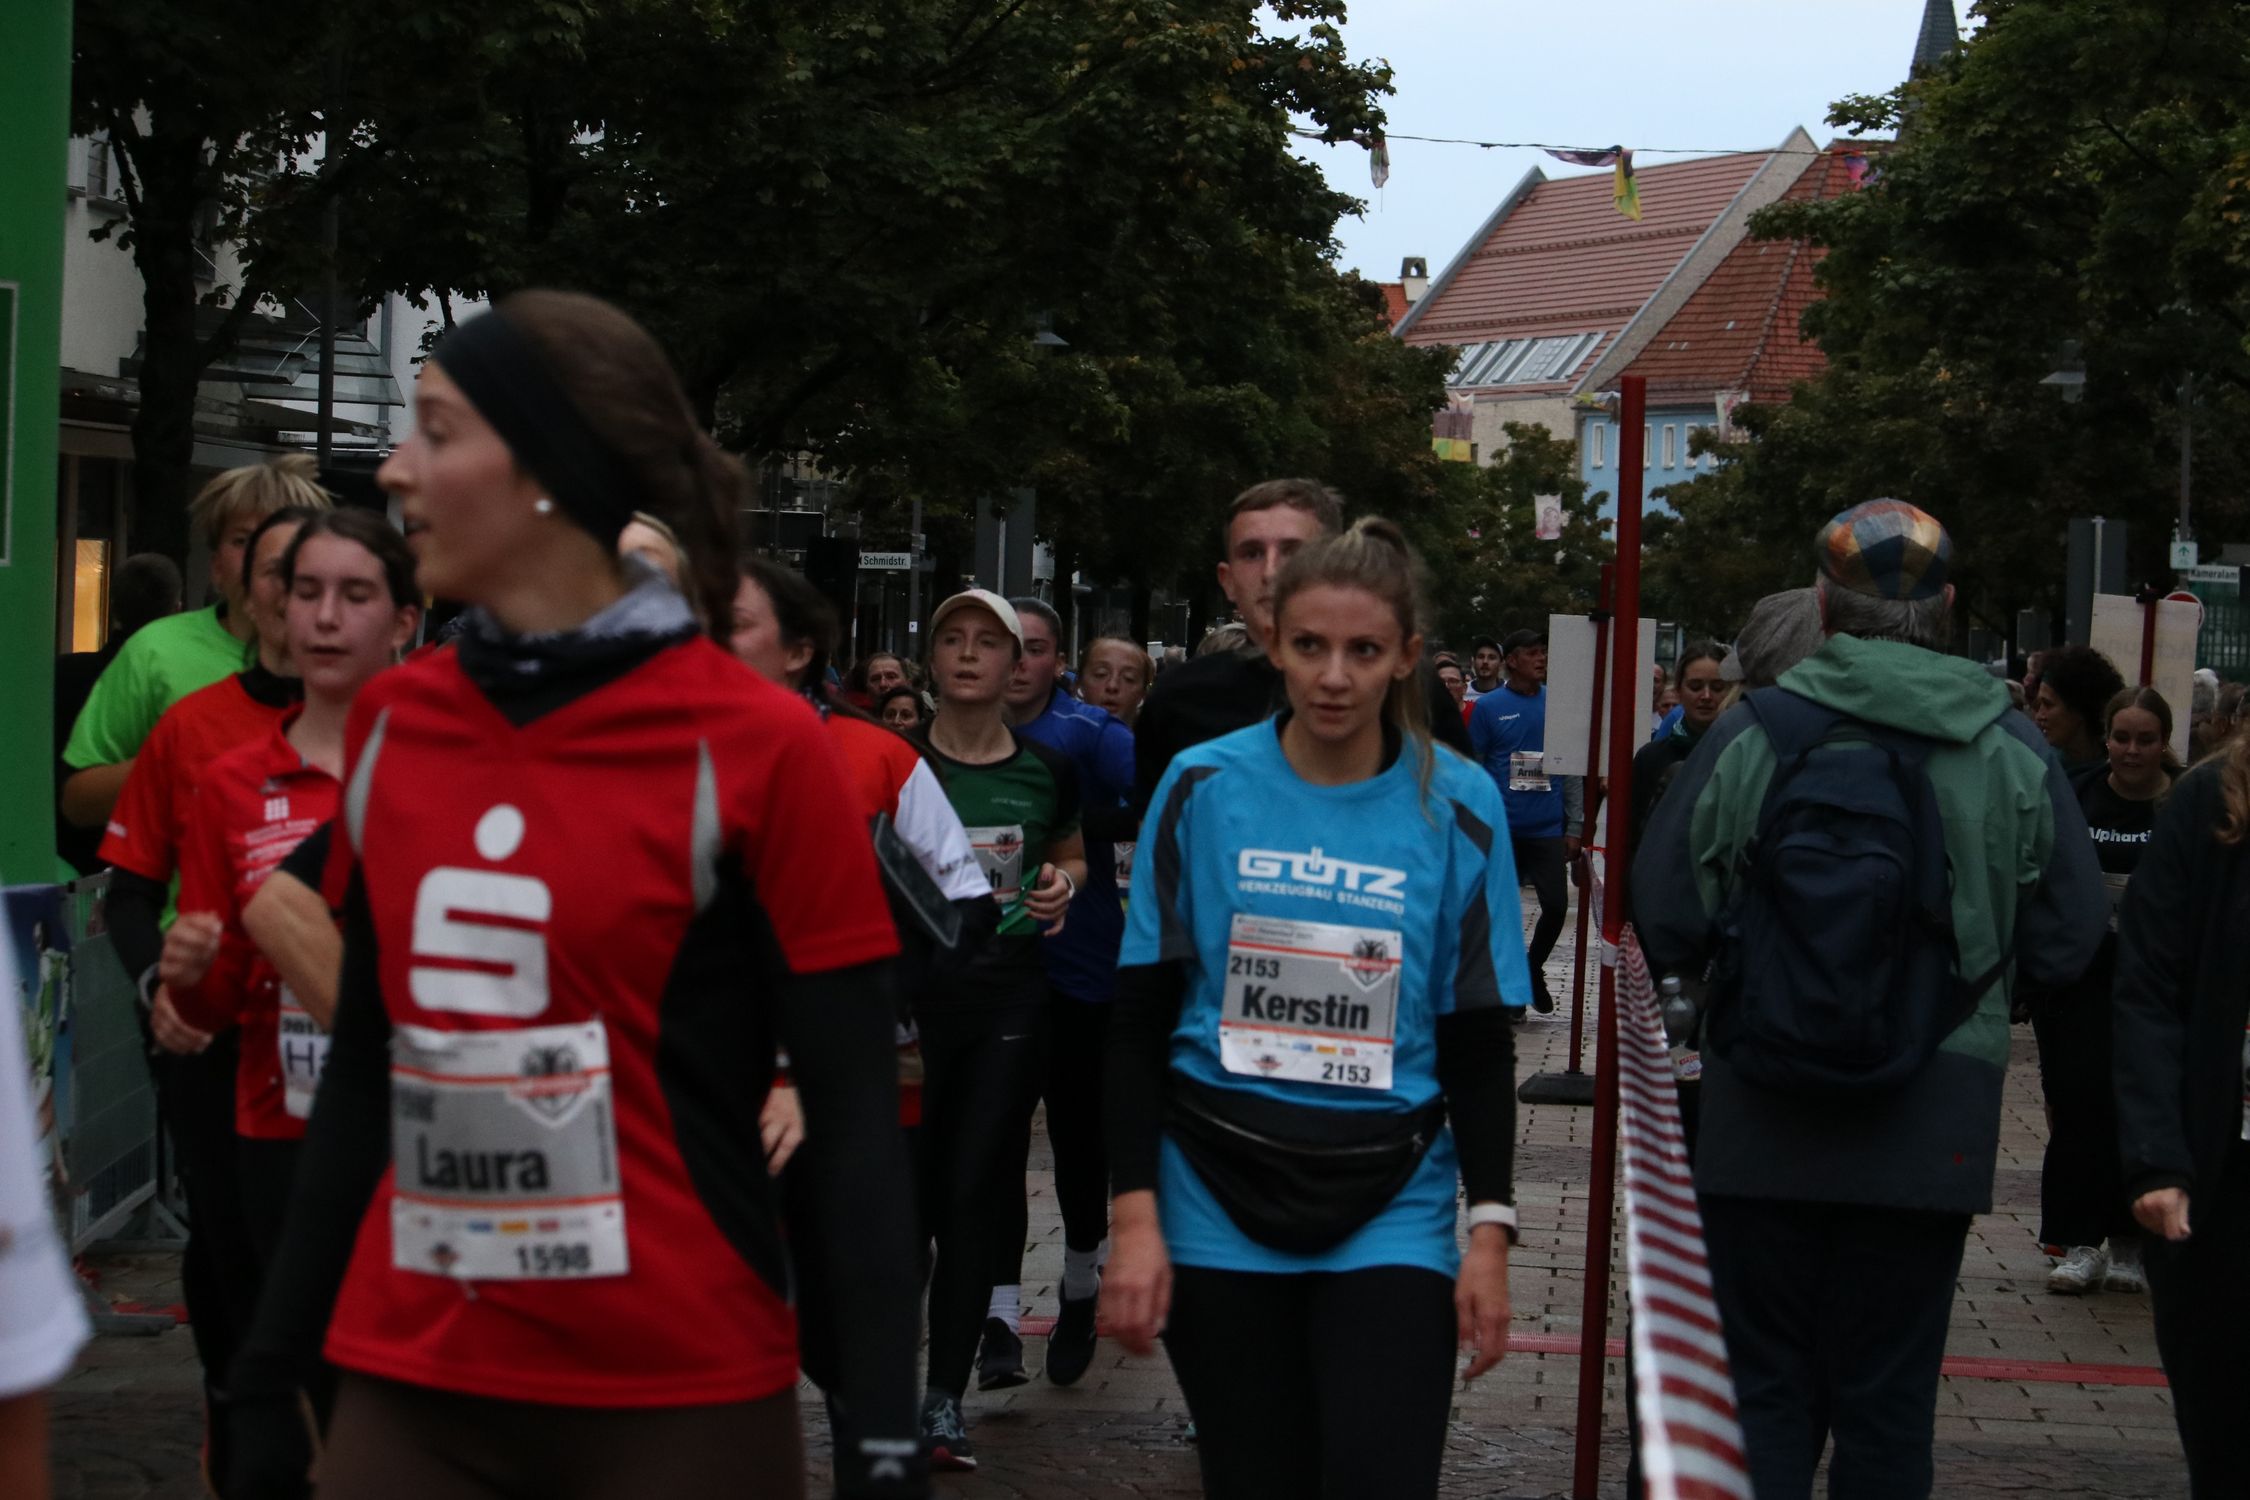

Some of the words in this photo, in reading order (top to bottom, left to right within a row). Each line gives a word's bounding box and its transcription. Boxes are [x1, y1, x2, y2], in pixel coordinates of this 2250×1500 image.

[864, 555, 908, 565] Schmidstr.
[2190, 568, 2240, 579] Kameralam
[1230, 956, 1280, 979] 2153
[1241, 984, 1370, 1031] Kerstin
[1322, 1062, 1371, 1084] 2153
[416, 1133, 549, 1191] Laura
[515, 1244, 591, 1273] 1598
